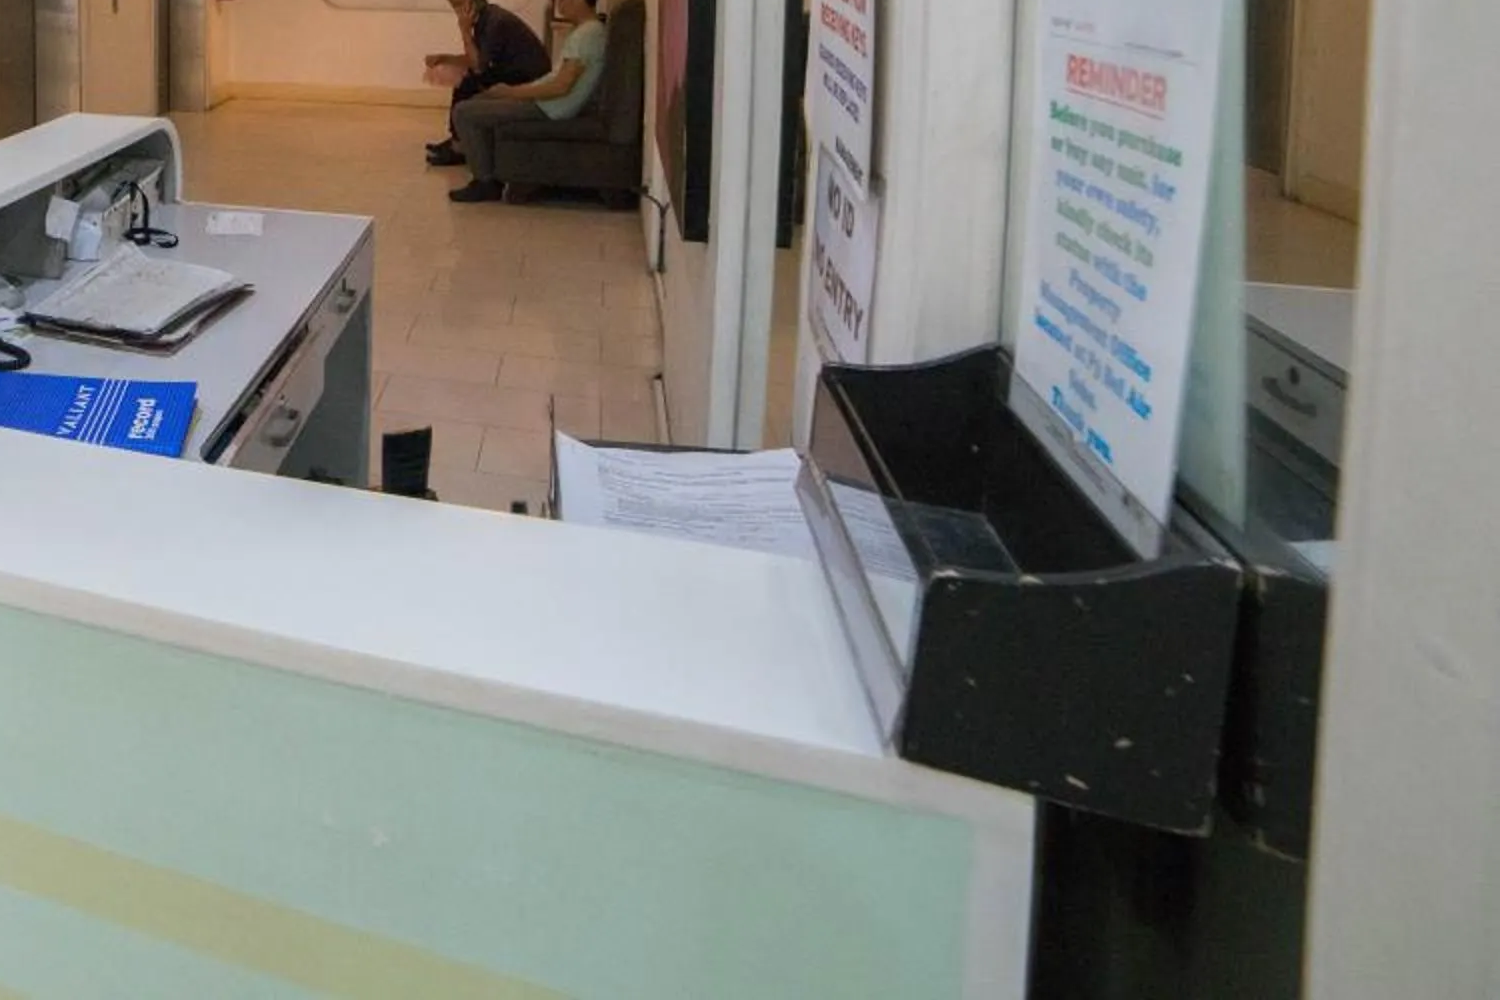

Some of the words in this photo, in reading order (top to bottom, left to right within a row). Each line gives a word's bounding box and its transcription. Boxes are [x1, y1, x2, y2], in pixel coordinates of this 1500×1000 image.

[1066, 53, 1167, 112] REMINDER
[1050, 100, 1088, 132] Before
[1090, 119, 1115, 141] you
[1117, 129, 1182, 168] purchase
[825, 255, 864, 342] ENTRY
[56, 384, 97, 435] VALIANT
[127, 398, 156, 439] record
